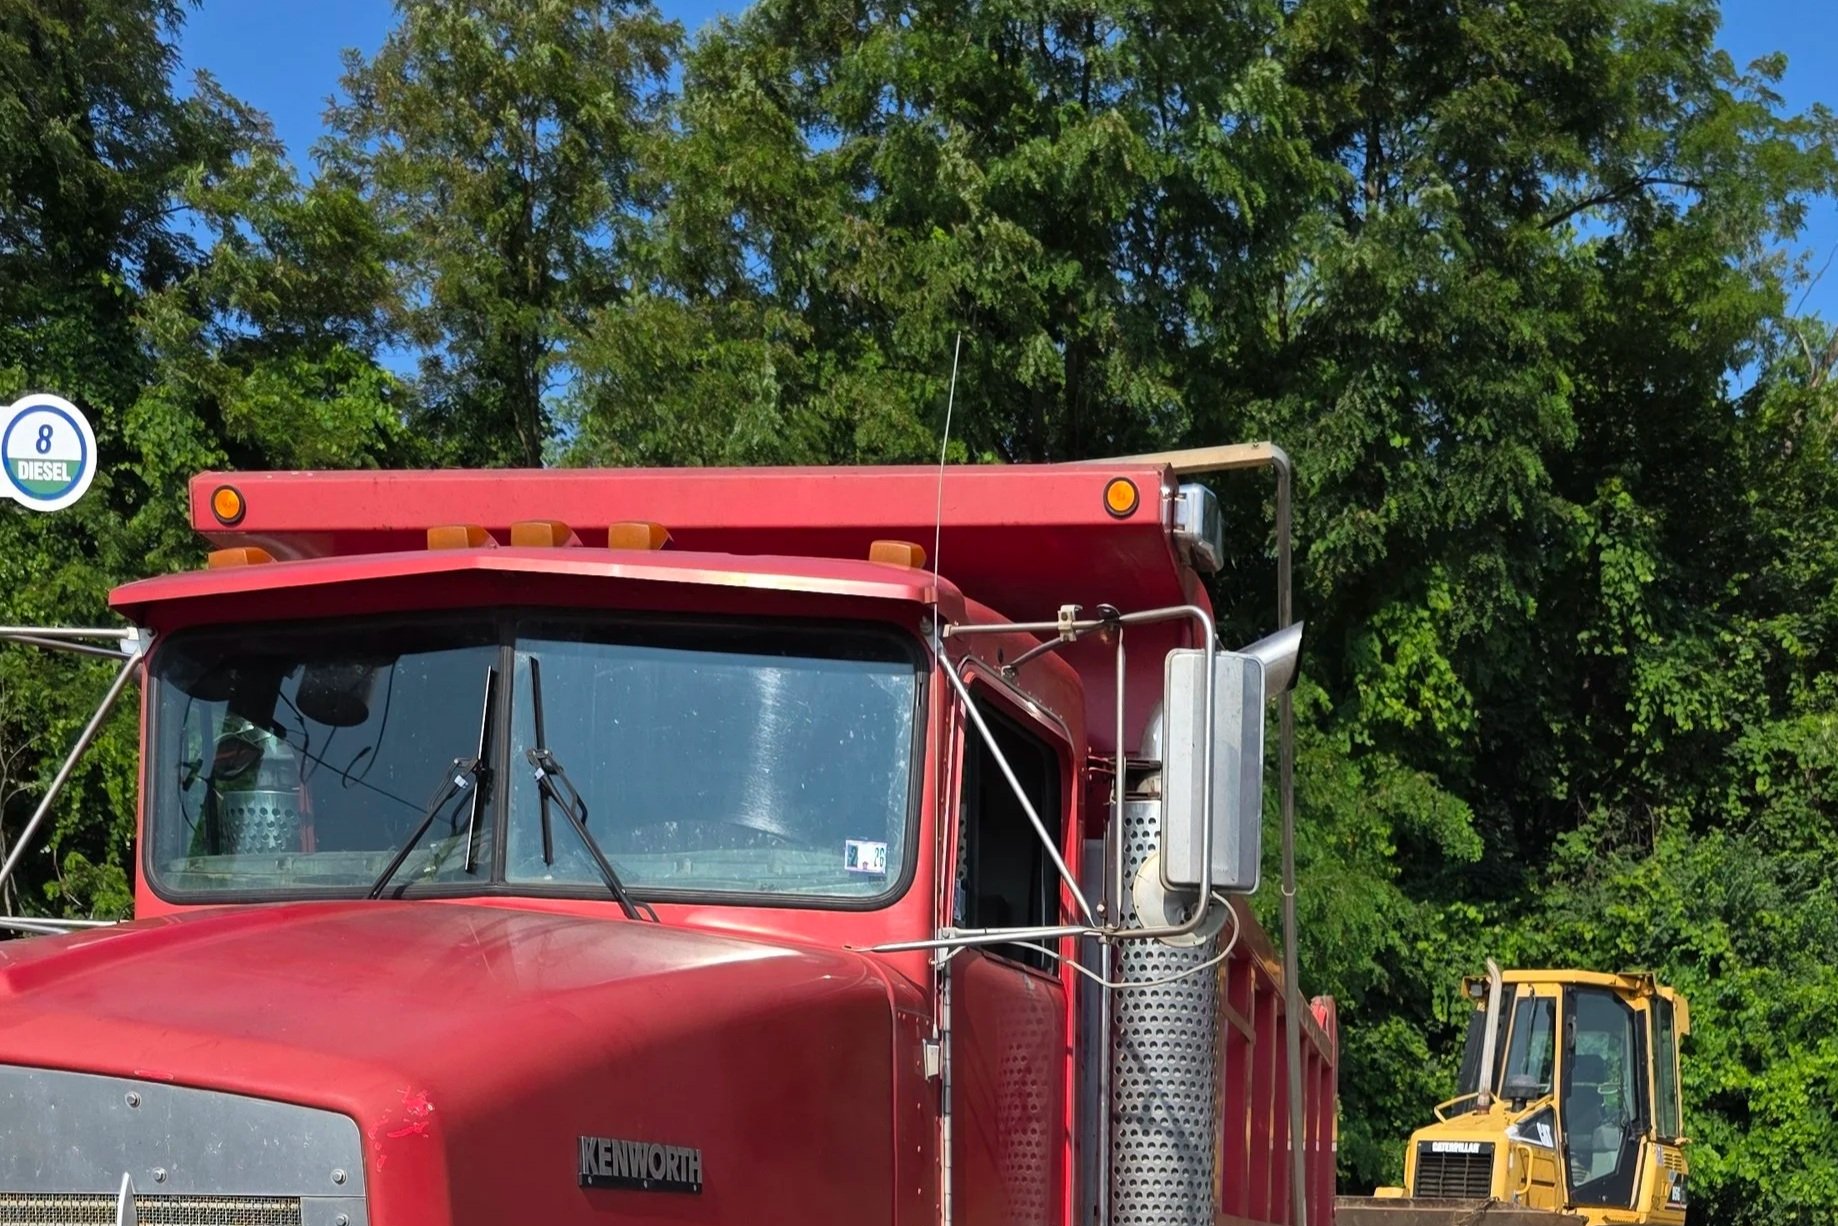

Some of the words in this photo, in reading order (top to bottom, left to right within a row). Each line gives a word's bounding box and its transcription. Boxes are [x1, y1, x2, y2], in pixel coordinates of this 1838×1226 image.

[36, 424, 53, 454] 8
[18, 460, 72, 482] DIESEL
[873, 847, 885, 868] 26
[1432, 1141, 1480, 1153] CATERPILLAR
[579, 1135, 702, 1184] KENWORTH
